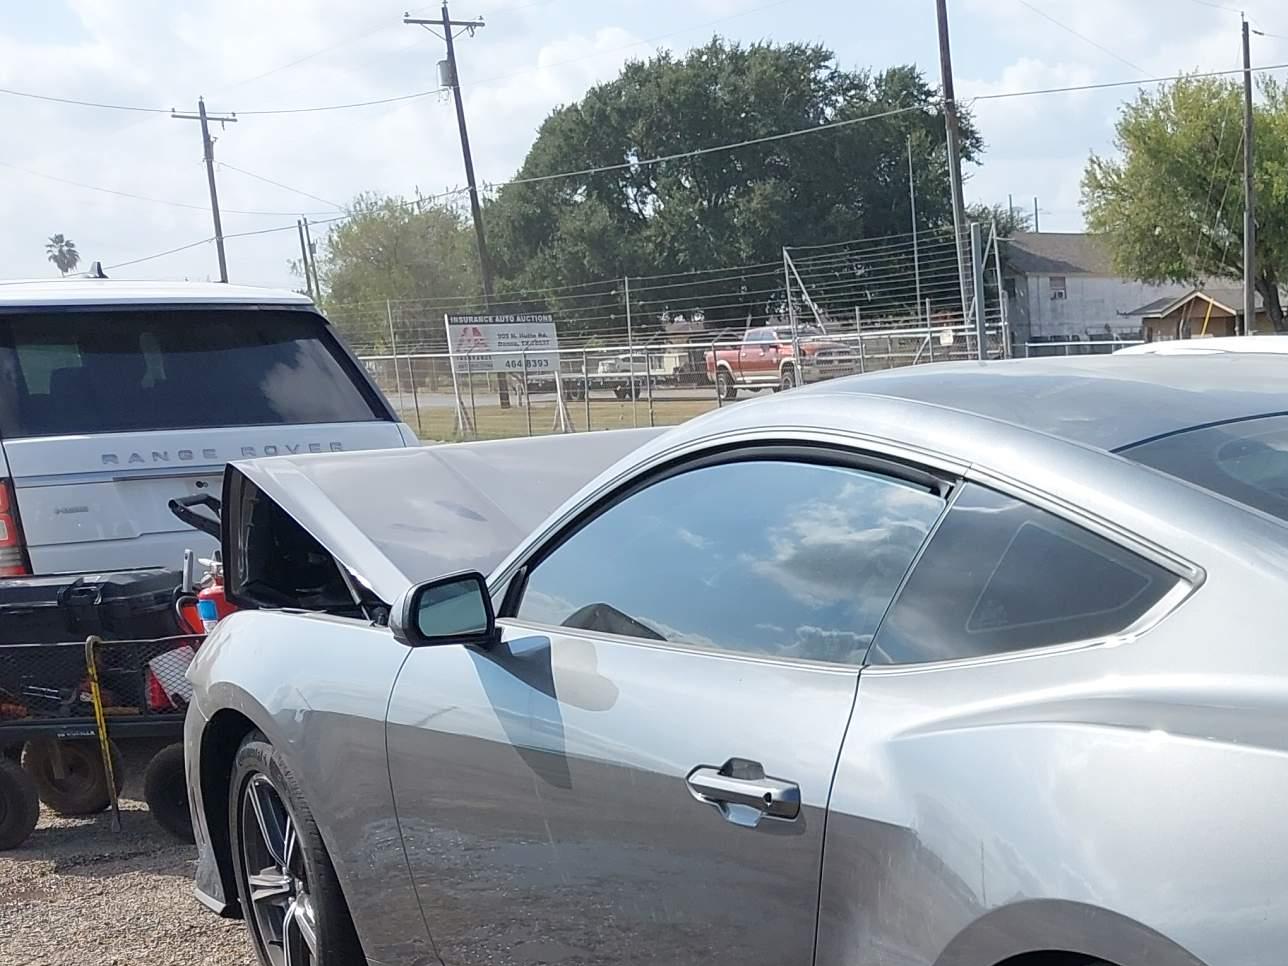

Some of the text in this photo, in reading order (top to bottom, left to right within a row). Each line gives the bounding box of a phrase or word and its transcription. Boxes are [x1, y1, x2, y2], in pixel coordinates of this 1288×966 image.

[450, 314, 553, 324] INSURANCE AUTO AUCTIONS
[504, 360, 549, 369] 4648393
[101, 441, 344, 465] RANGE ROVER
